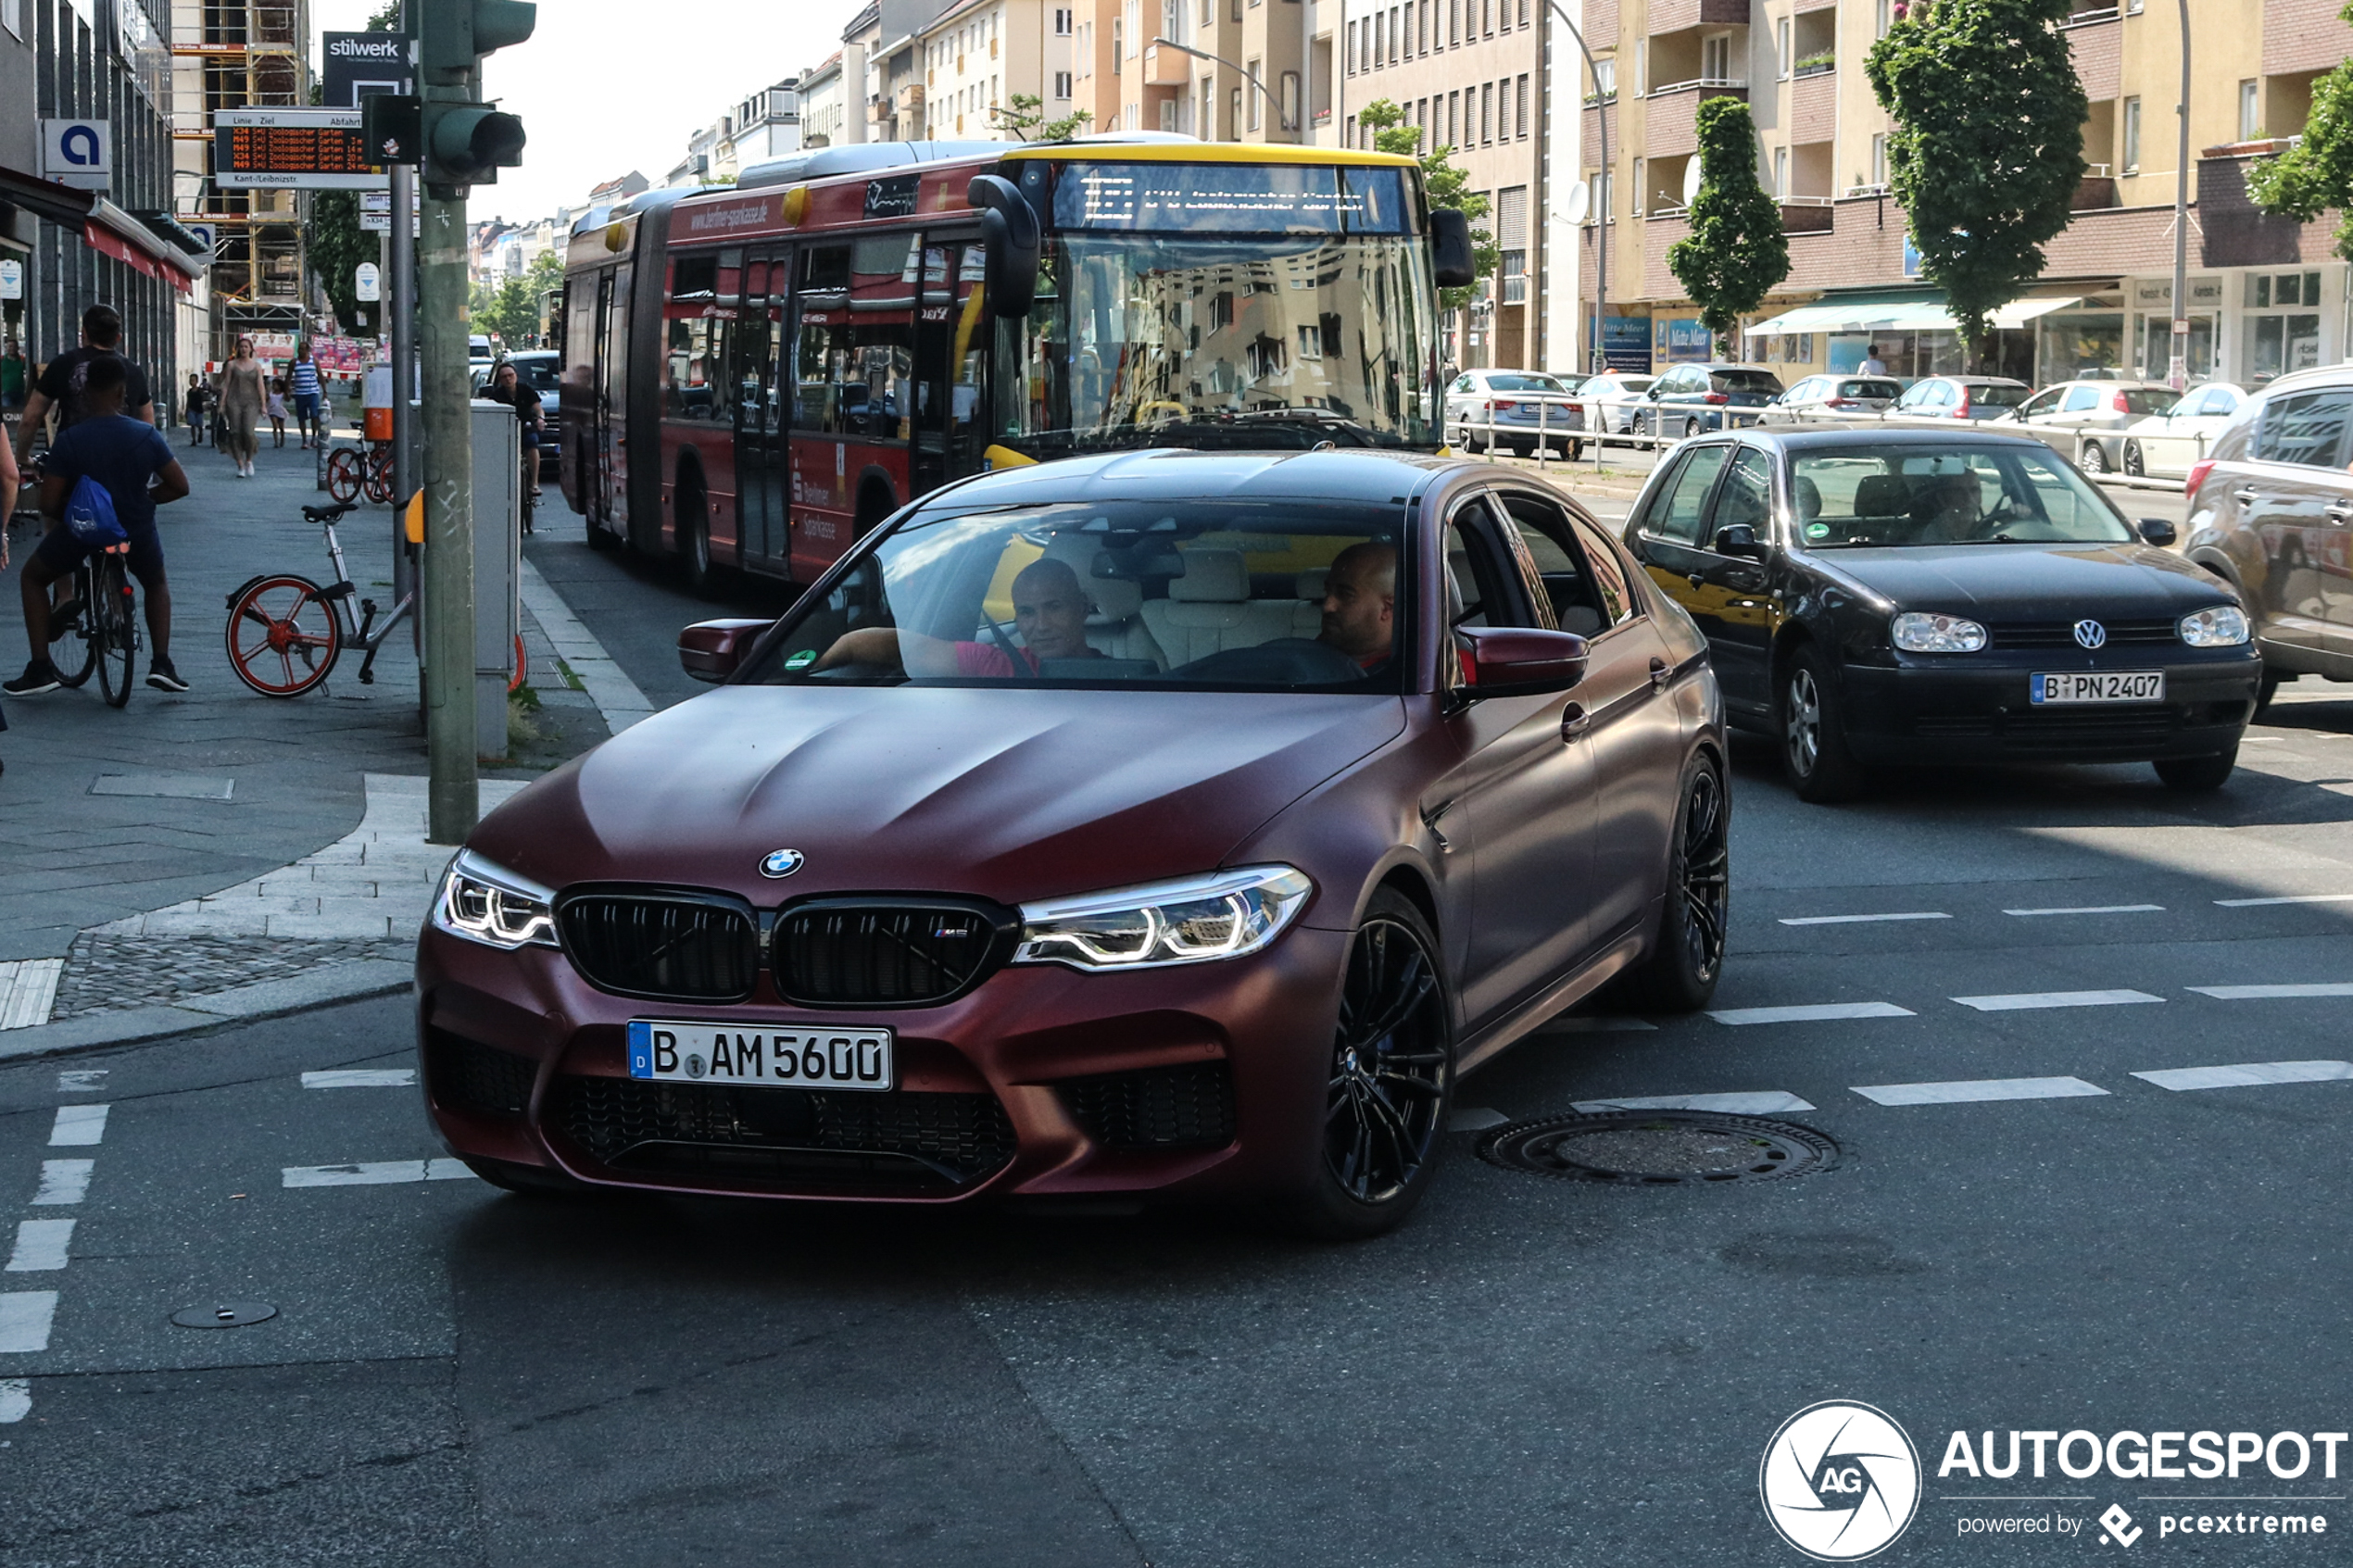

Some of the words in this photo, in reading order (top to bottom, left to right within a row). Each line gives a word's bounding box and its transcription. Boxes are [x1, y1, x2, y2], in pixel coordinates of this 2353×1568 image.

[330, 39, 398, 56] stilwerk
[233, 117, 252, 125] Linie
[259, 117, 275, 125] Ziel
[330, 118, 361, 126] Abfahrt
[269, 129, 315, 137] Zoologischer
[269, 137, 315, 145] Zoologischer
[269, 145, 315, 154] Zoologischer
[269, 154, 315, 162] Zoologischer
[269, 162, 315, 170] Zoologischer
[234, 175, 298, 183] Kant-/Leibnizstr.
[1624, 323, 1646, 332] Meer
[1671, 329, 1689, 347] Mitte
[1690, 330, 1707, 346] Meer
[804, 514, 836, 540] Sparkasse
[2045, 678, 2058, 698] B
[2076, 677, 2103, 698] PN
[2108, 676, 2159, 698] 2407
[653, 1030, 679, 1073] B
[710, 1033, 762, 1077] AM
[774, 1035, 881, 1082] 5600
